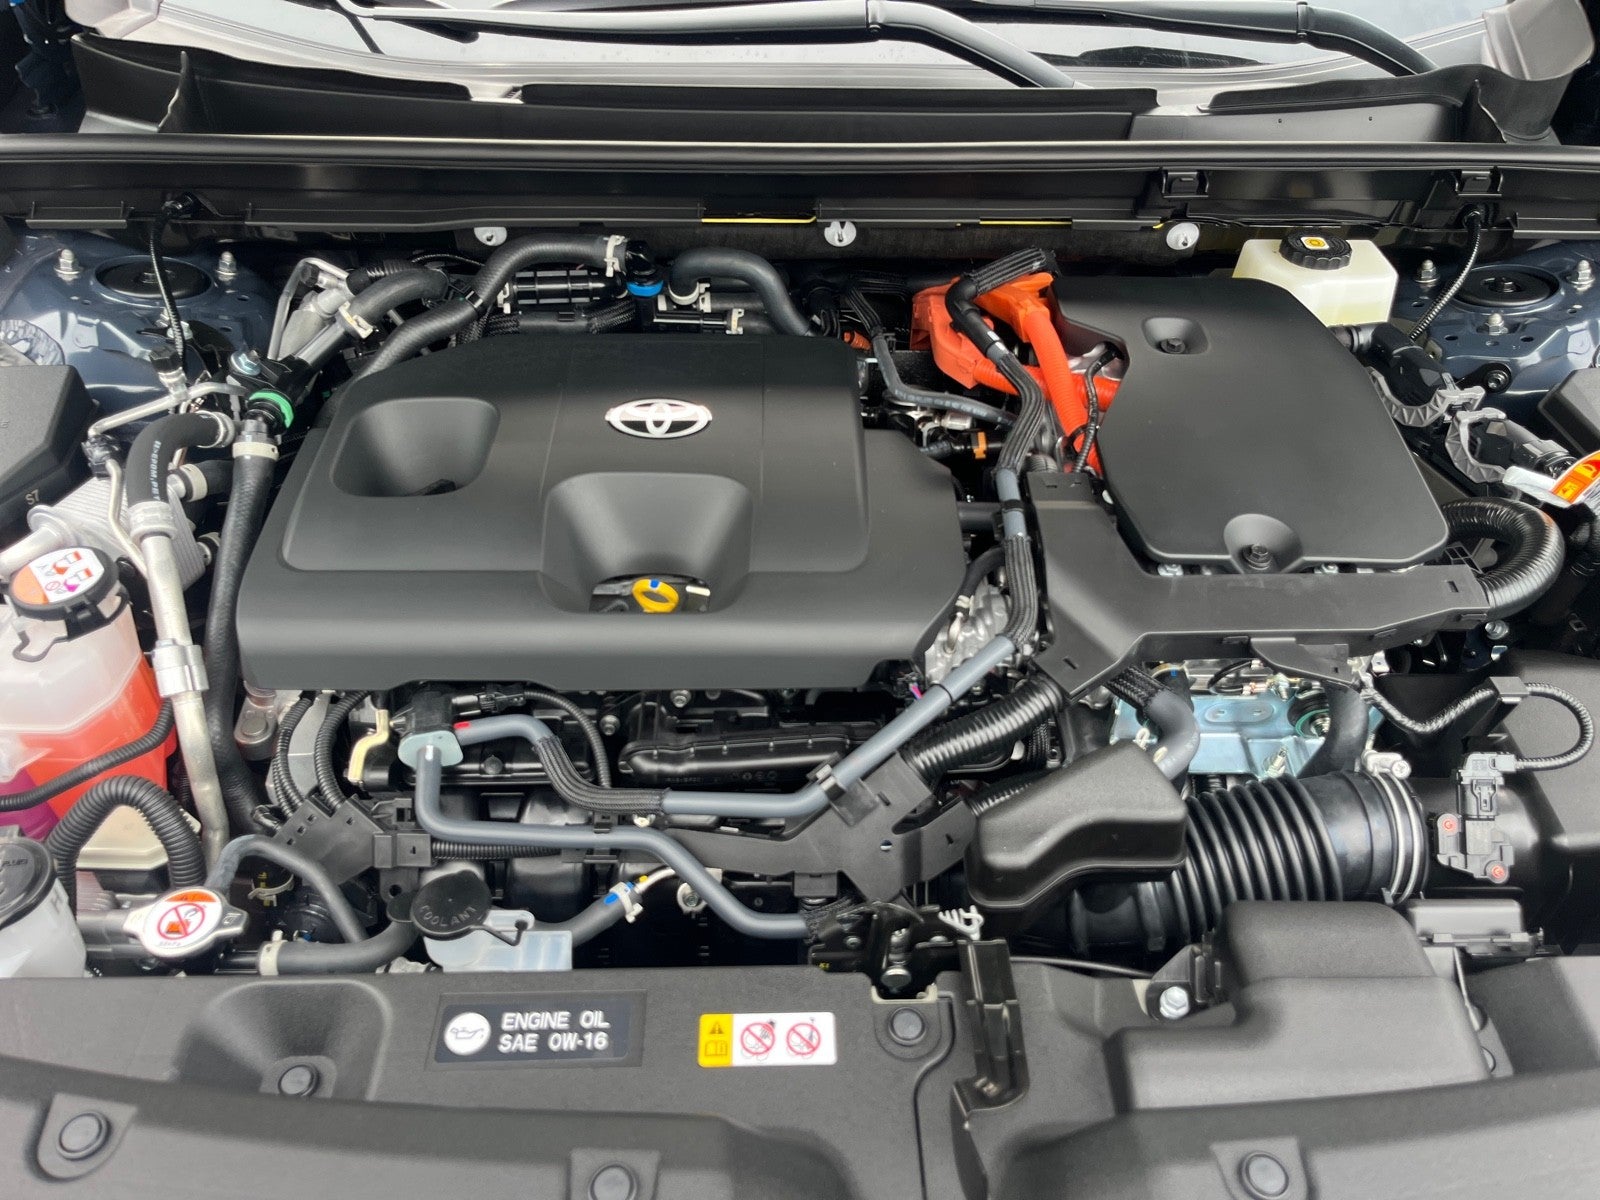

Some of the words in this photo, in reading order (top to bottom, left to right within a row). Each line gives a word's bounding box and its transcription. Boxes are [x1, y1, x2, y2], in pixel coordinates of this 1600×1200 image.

[421, 905, 476, 927] COOLANT
[502, 1011, 571, 1031] ENGINE
[579, 1010, 611, 1029] OIL
[498, 1033, 539, 1053] SAE
[548, 1031, 609, 1051] 0W-16
